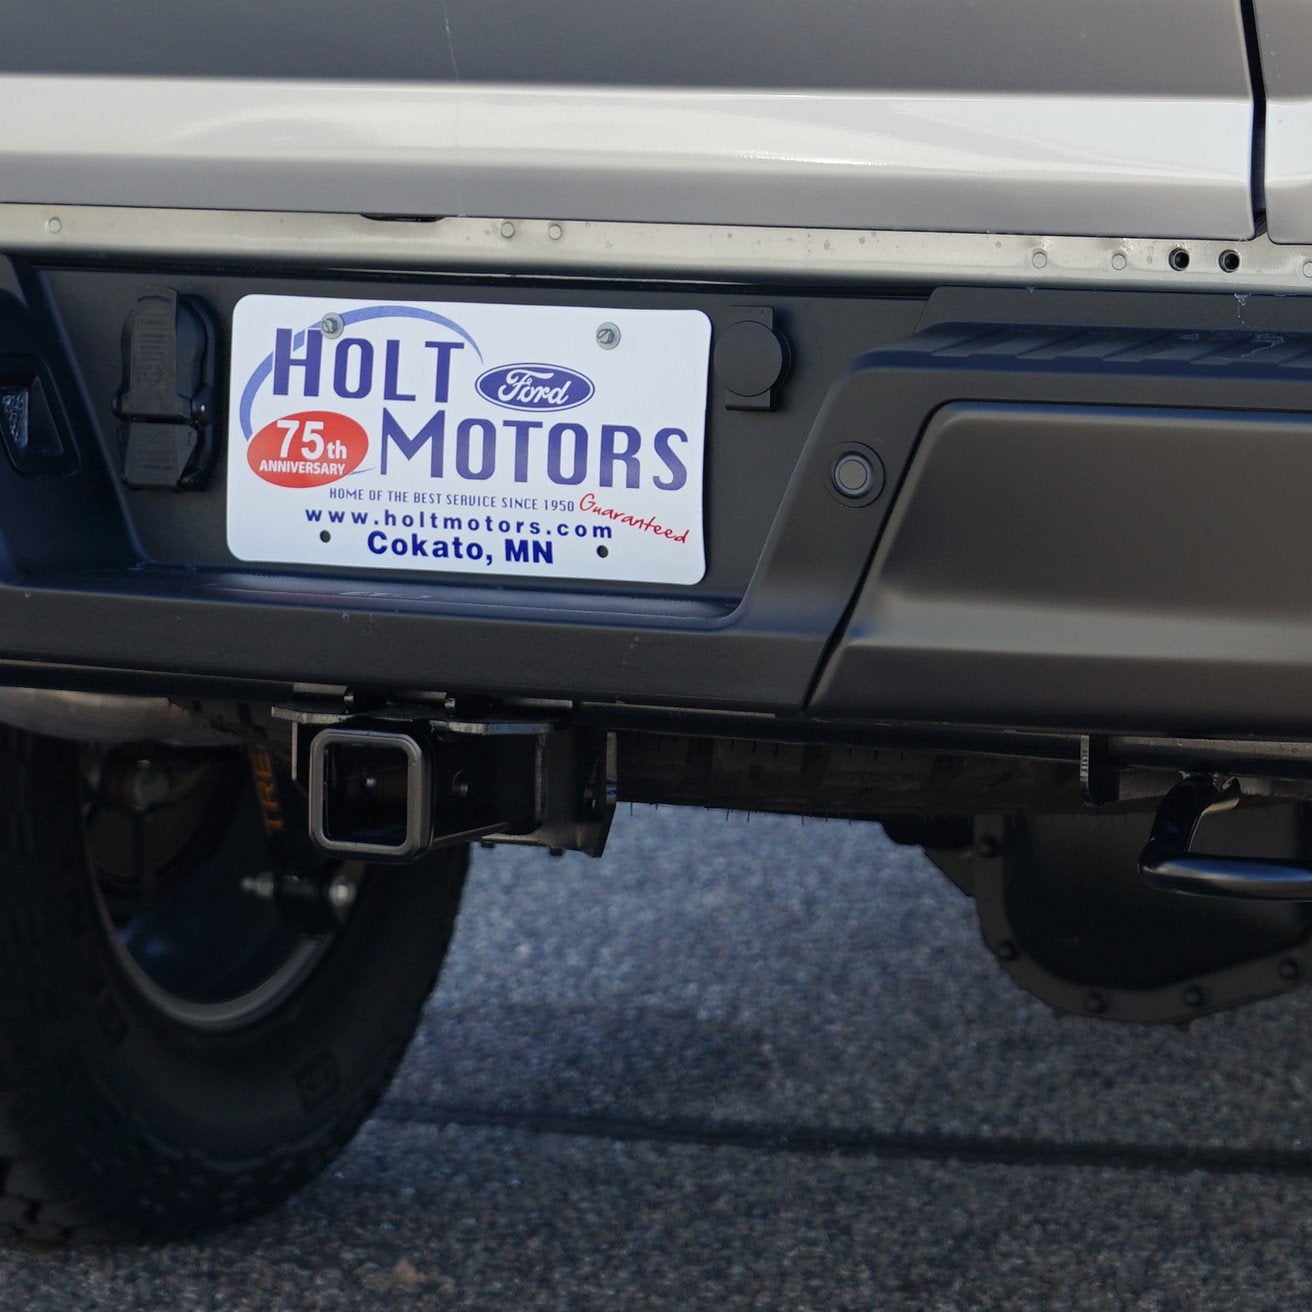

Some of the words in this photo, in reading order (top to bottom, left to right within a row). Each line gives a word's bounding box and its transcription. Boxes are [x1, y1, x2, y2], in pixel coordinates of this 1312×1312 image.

[272, 328, 464, 403] HOLT
[497, 368, 572, 405] Ford
[276, 420, 347, 460] 75th
[380, 407, 689, 491] MOTORS
[259, 459, 345, 476] ANNIVERSARY
[329, 487, 364, 501] HOME
[369, 489, 384, 502] OF
[388, 490, 409, 503] THE
[414, 492, 442, 505] BEST
[446, 494, 497, 508] SERVICE
[502, 497, 538, 510] SINCE
[544, 499, 575, 512] 1950
[305, 508, 612, 539] www.holtmotors.com
[579, 493, 689, 544] Guaranteed
[367, 530, 492, 566] Cokato,
[505, 539, 553, 563] MN
